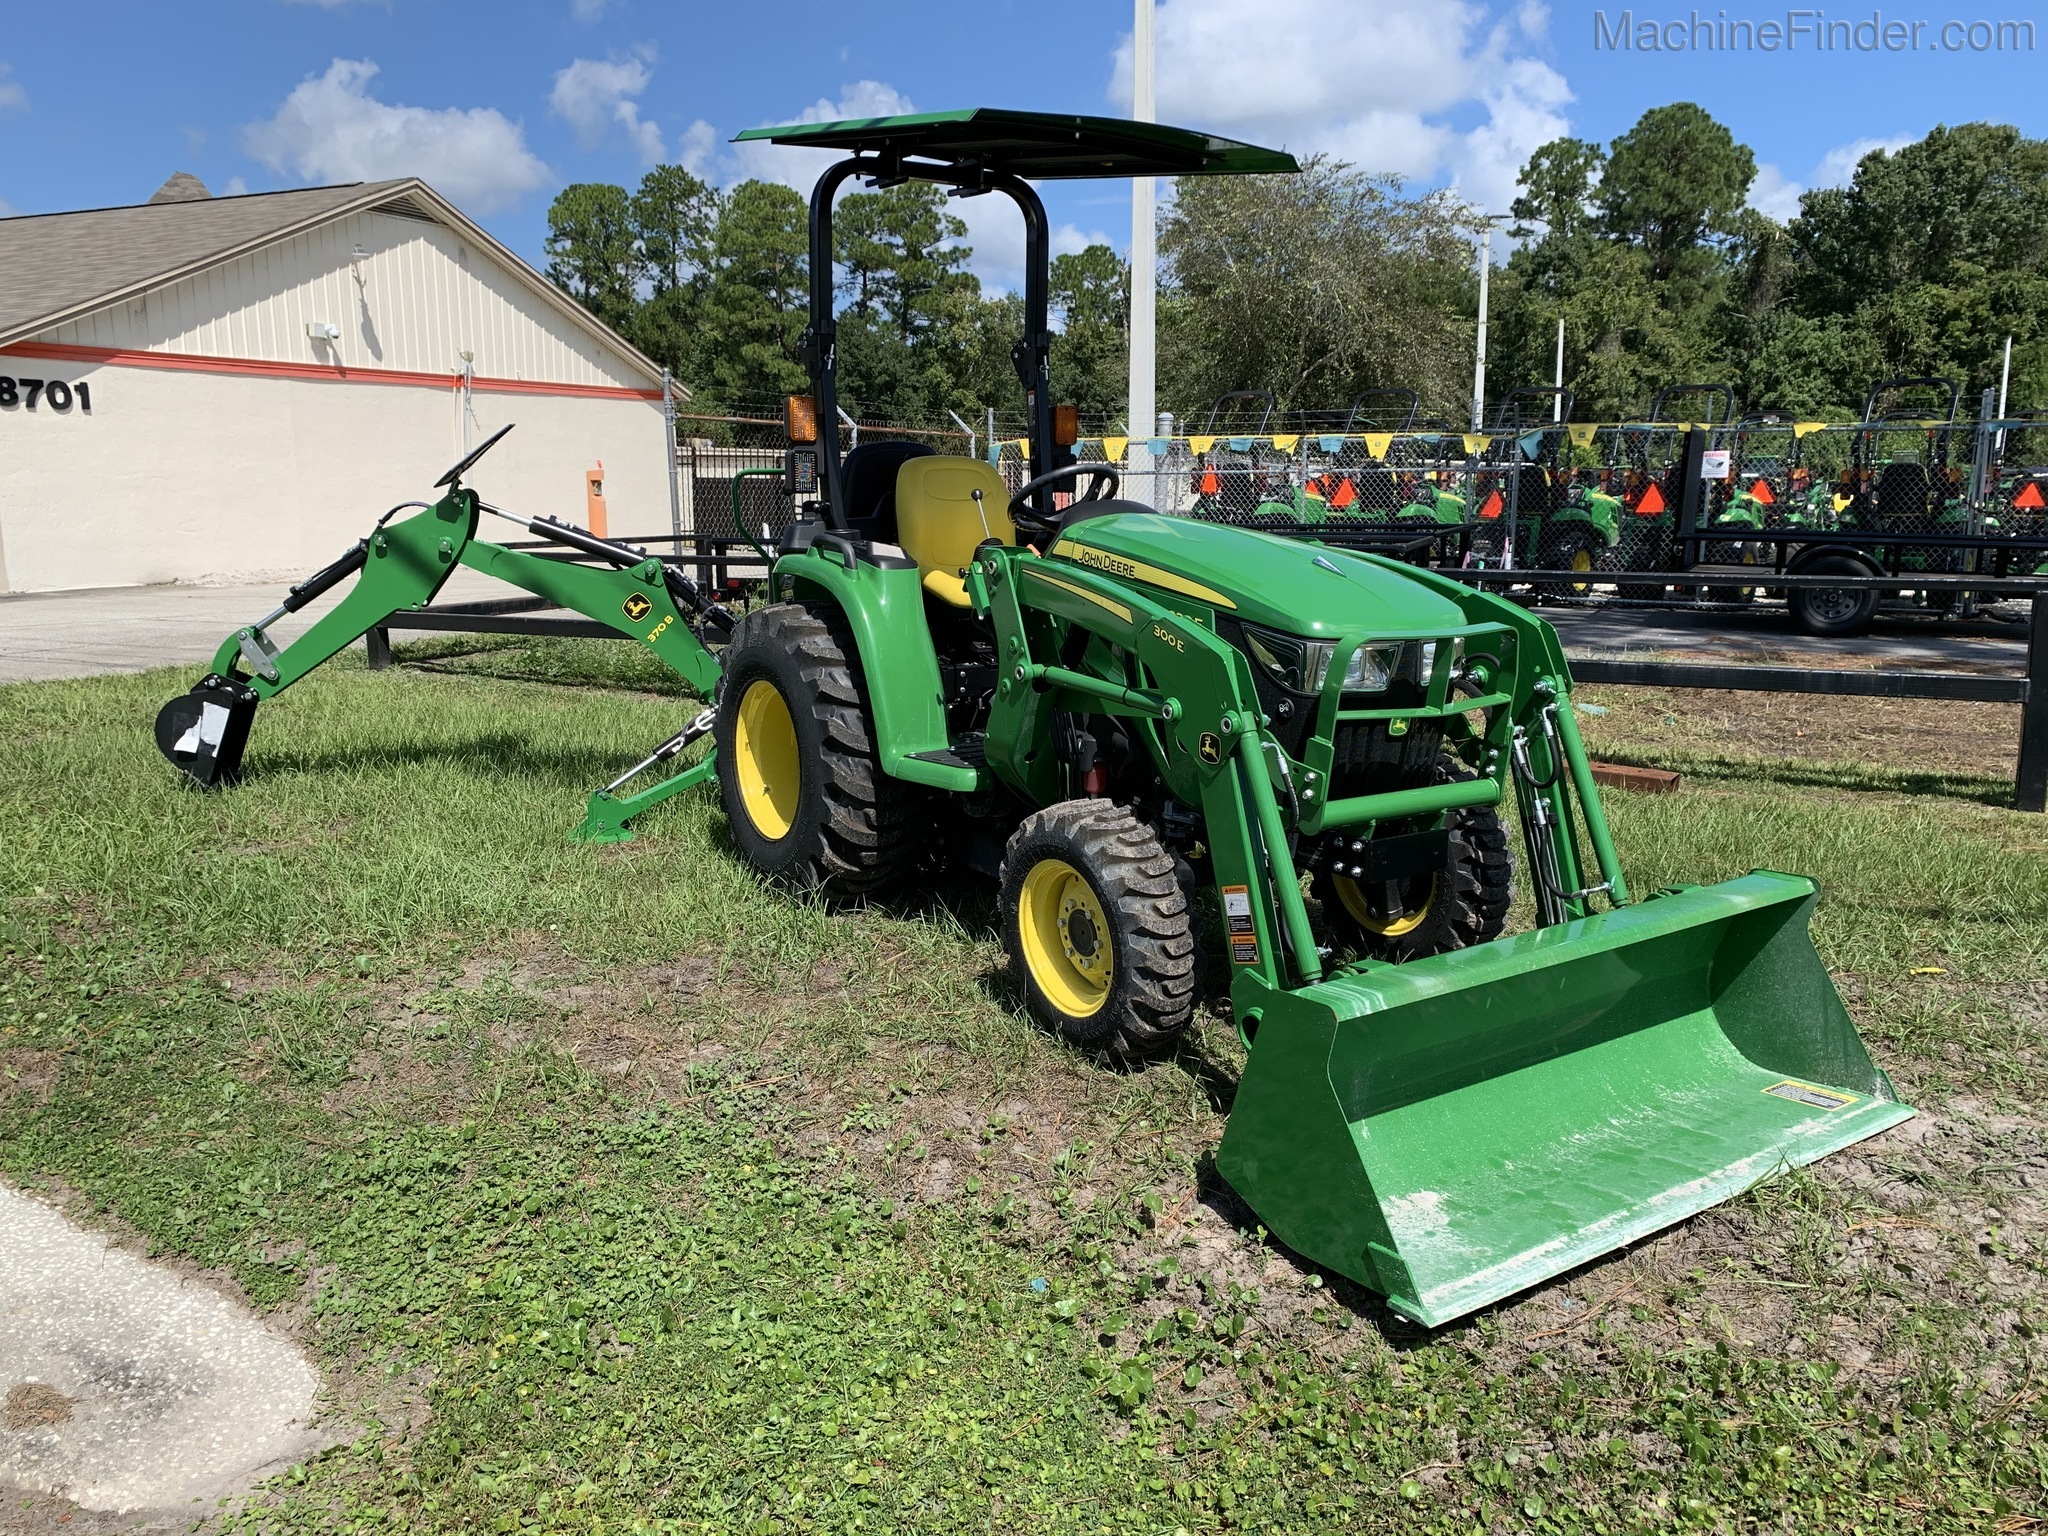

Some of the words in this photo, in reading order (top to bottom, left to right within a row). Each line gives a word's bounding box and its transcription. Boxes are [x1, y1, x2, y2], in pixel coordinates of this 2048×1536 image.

[0, 375, 91, 410] 8701
[1078, 548, 1103, 569] JOHN
[1103, 555, 1136, 578] DEERE
